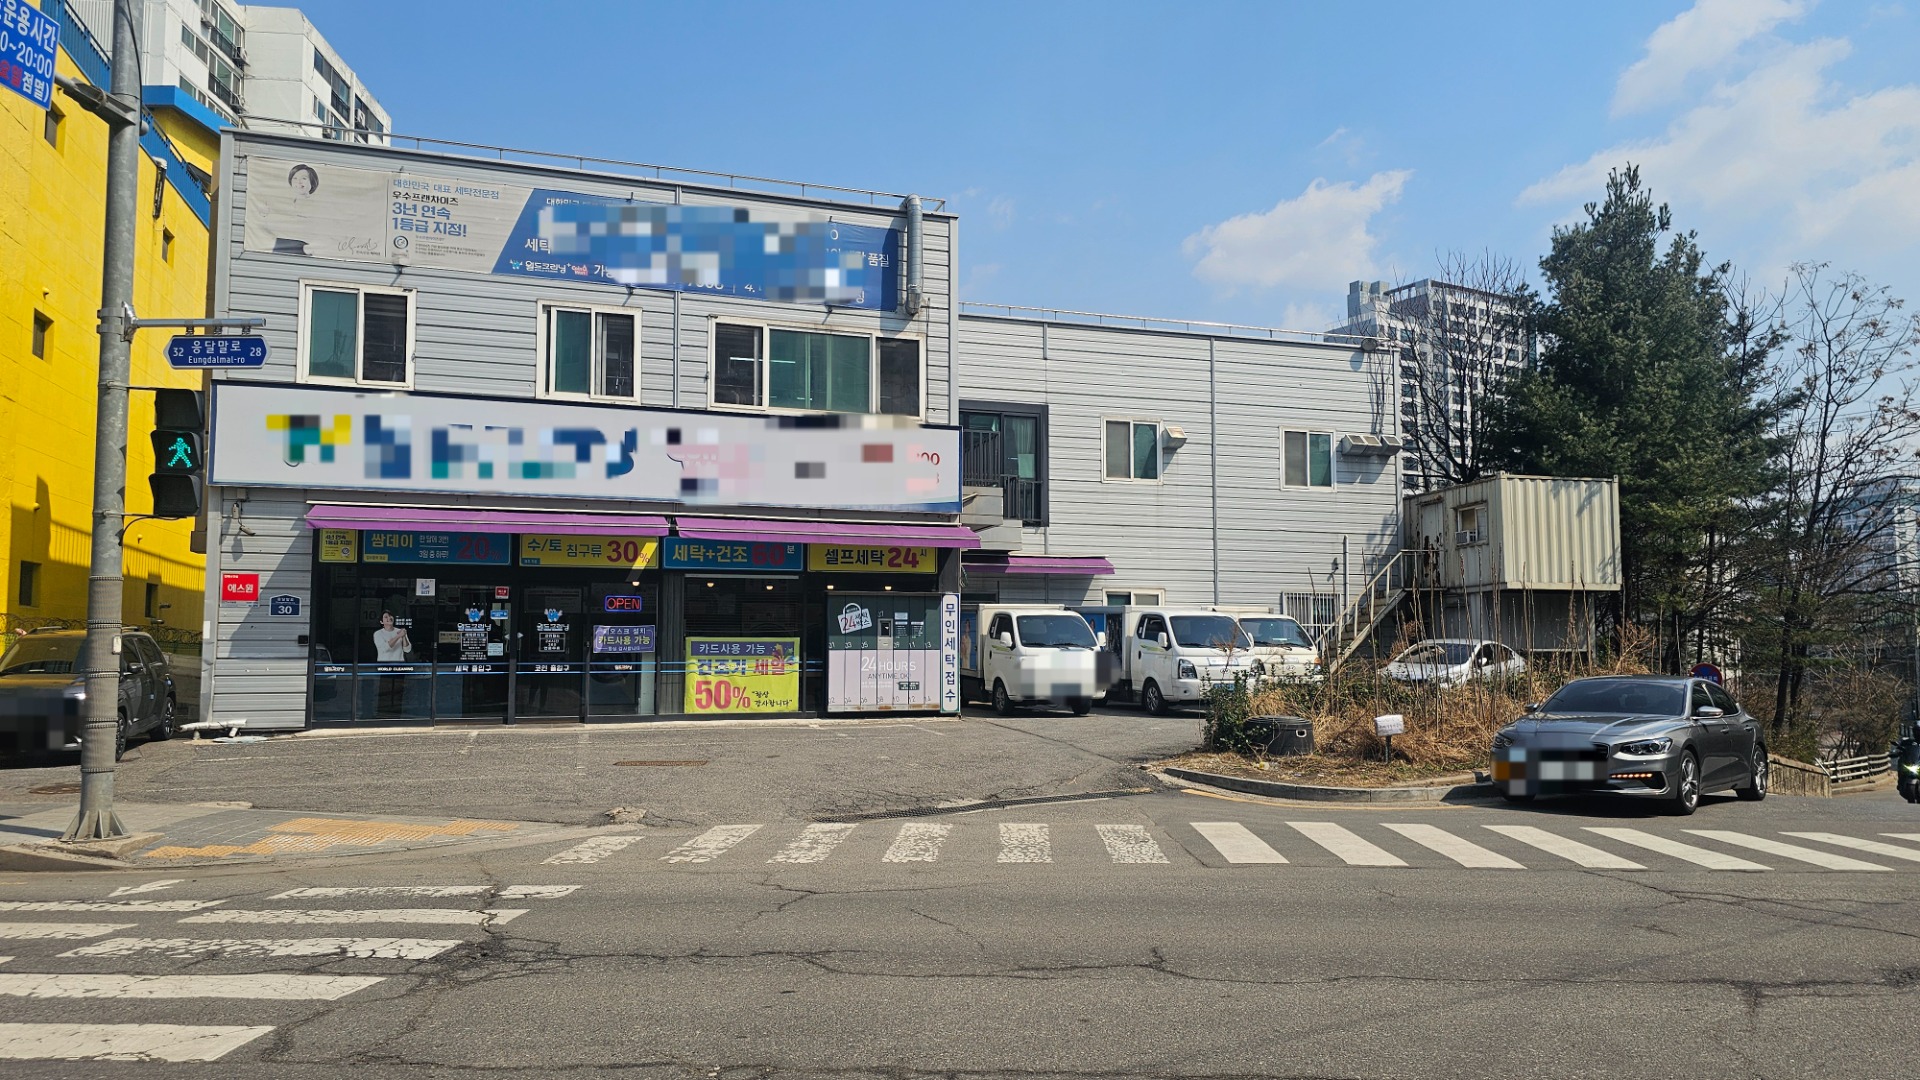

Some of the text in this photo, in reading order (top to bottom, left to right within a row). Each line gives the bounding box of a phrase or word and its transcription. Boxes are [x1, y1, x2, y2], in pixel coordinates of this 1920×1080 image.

[392, 190, 459, 206] 우수프랜차이즈
[393, 180, 500, 200] 대한민국 대표 세탁전문점
[392, 201, 451, 221] 3년 연속
[392, 217, 467, 238] 1등급 지정!
[867, 252, 889, 268] 품질
[173, 348, 184, 356] 32
[191, 340, 242, 354] 응달말로
[250, 347, 262, 357] 28
[188, 356, 246, 365] Eungdalmal-ro
[527, 538, 602, 558] 수/토 침구류
[606, 540, 650, 563] 30%
[672, 544, 748, 562] 세탁+건조
[825, 548, 885, 566] 셀프세탁
[227, 583, 254, 594] 에스원
[278, 605, 293, 615] 30
[607, 598, 640, 610] OPEN
[841, 617, 857, 631] 24
[598, 636, 650, 646] 카드사용 가능
[699, 643, 766, 654] 카드사용 가능
[944, 603, 956, 703] 무인세탁접수
[752, 658, 785, 676] 세일
[861, 656, 917, 671] 24 HOURS
[695, 680, 751, 710] 50%
